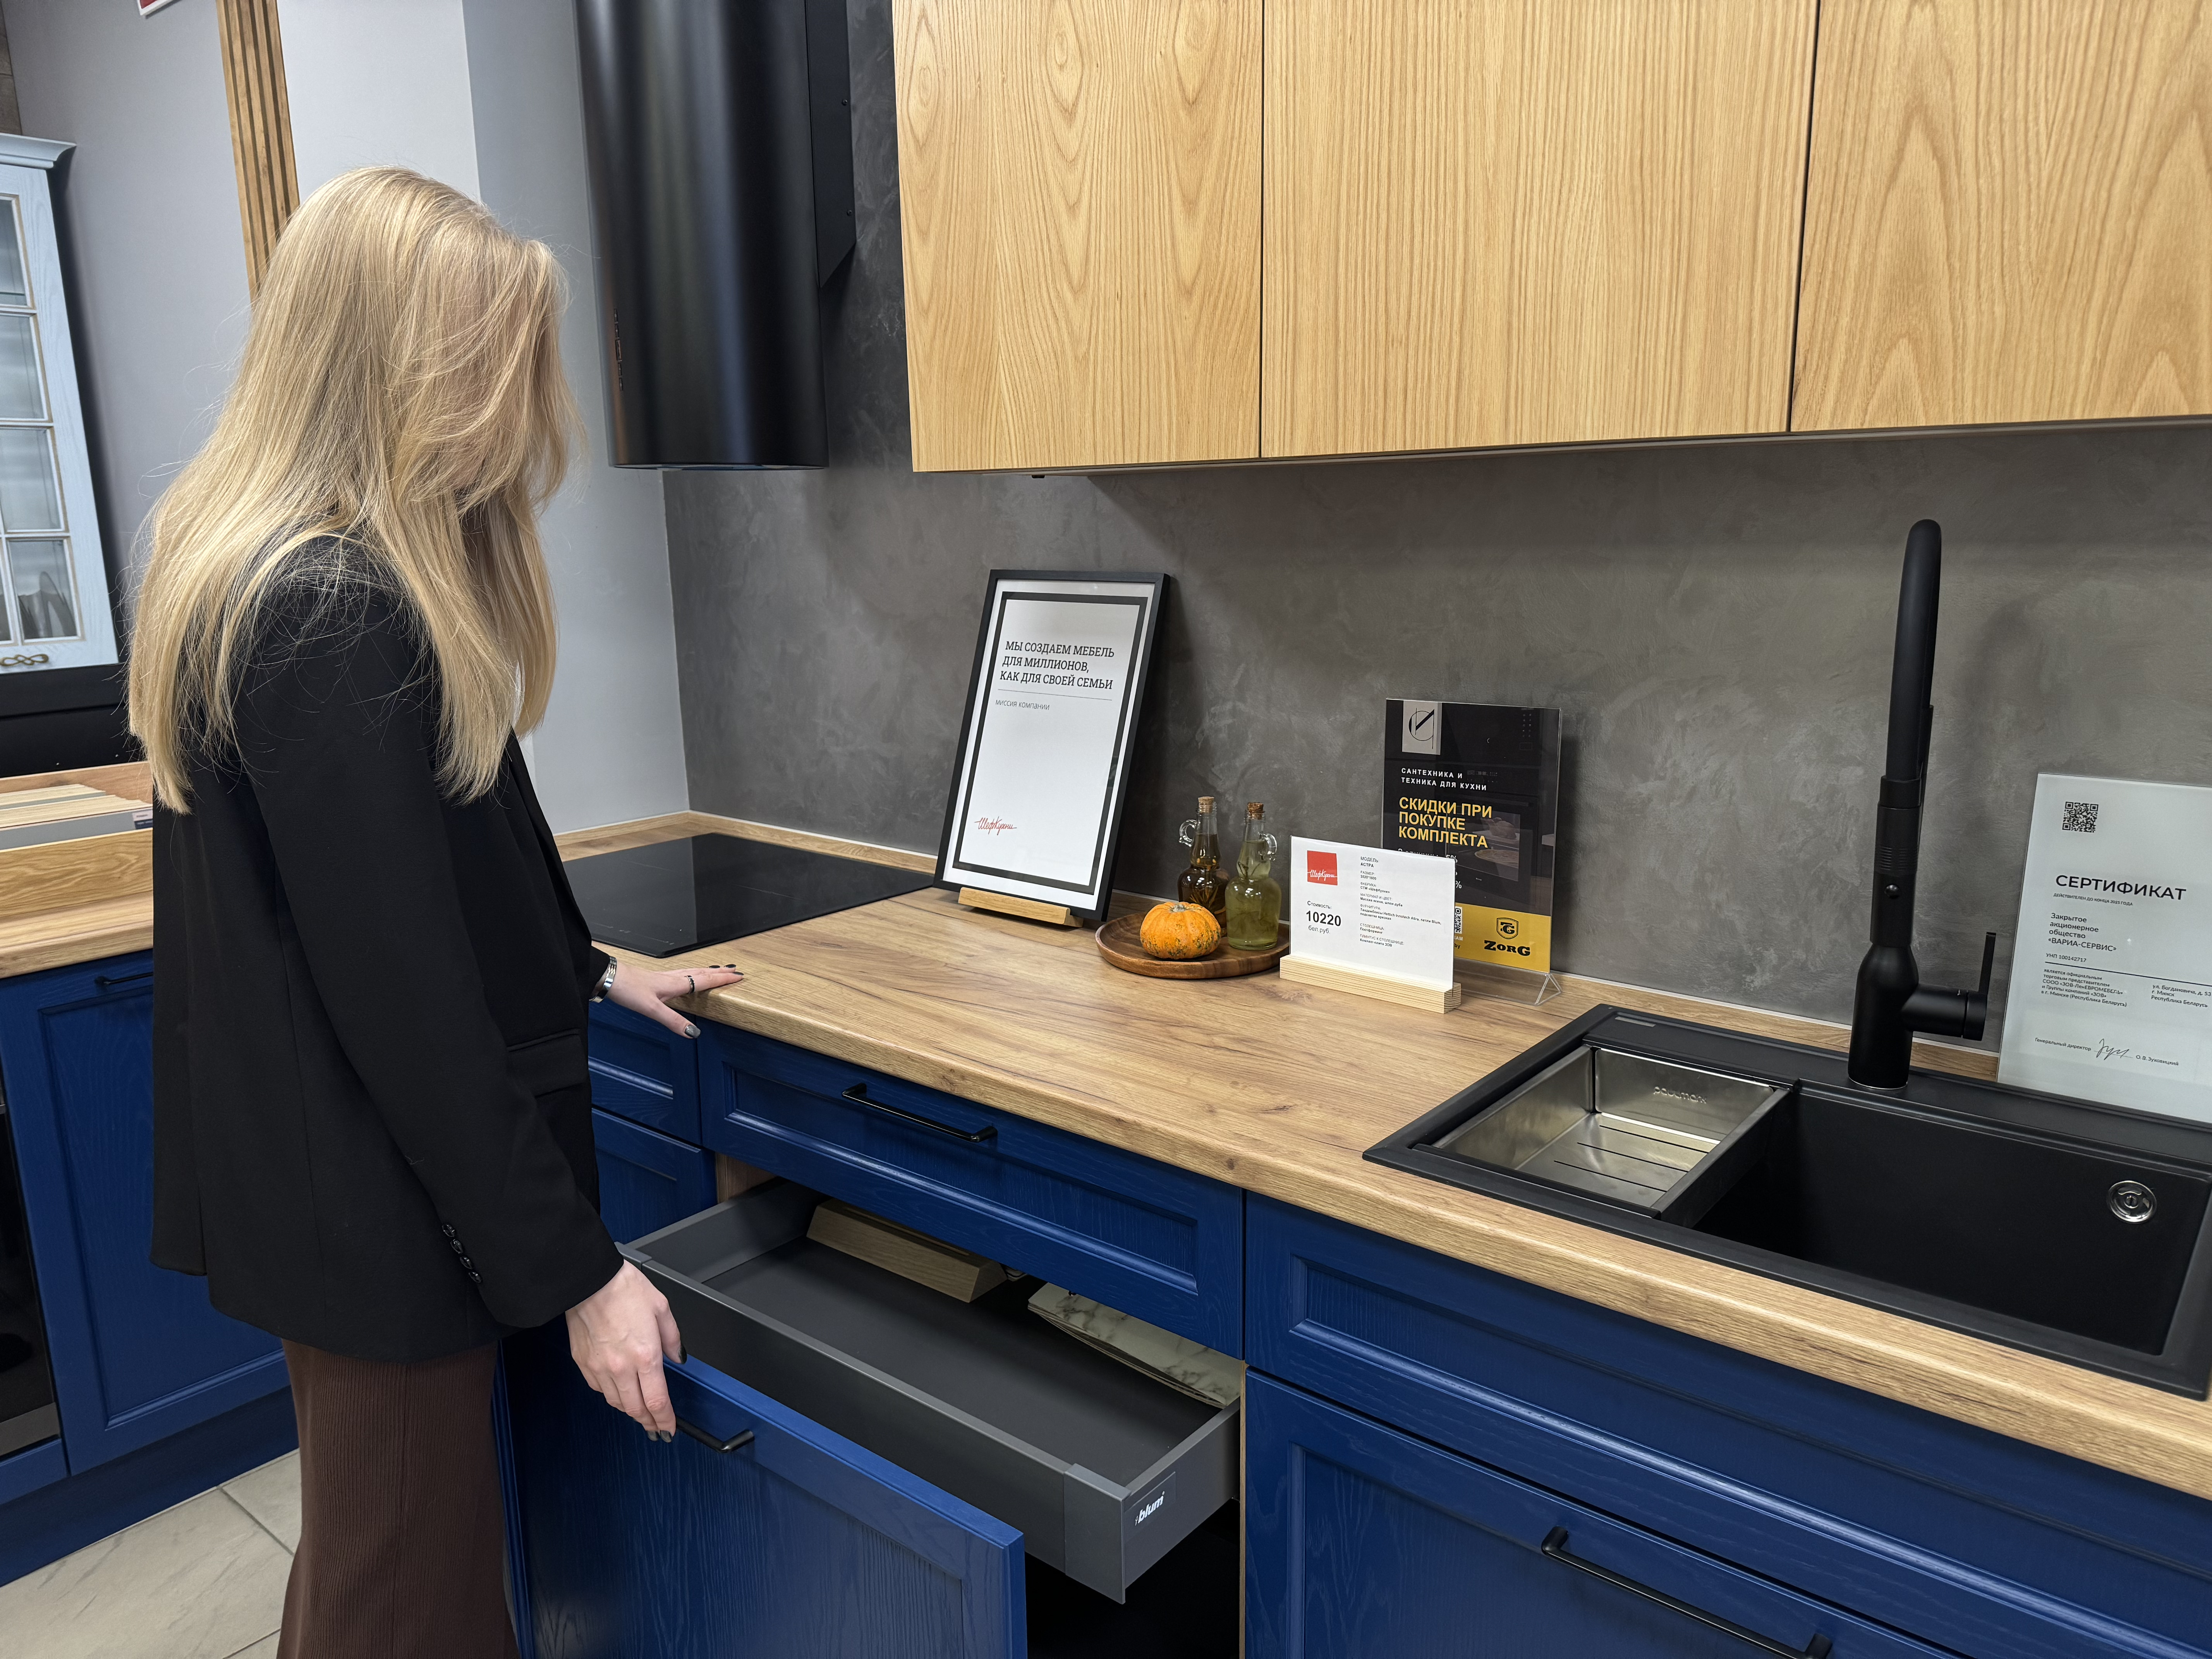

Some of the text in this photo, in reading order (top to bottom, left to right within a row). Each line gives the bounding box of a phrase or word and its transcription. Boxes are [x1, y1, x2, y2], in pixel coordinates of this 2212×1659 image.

[1005, 641, 1114, 657] МЫ СОЗДАЕМ МЕБЕЛЬ
[1002, 656, 1089, 673] ДЛЯ МИЛЛИОНОВ,
[1000, 671, 1113, 689] КАК ДЛЯ СВОЕЙ СЕМЬИ
[1401, 768, 1454, 778] САНТЕХНИКА
[1401, 777, 1437, 786] ТЕХНИКА
[1460, 783, 1487, 791] КУХНИ
[1399, 797, 1492, 818] СКИДКИ ПРИ
[1399, 811, 1465, 830] ПОКУПКЕ
[1399, 826, 1488, 848] КОМПЛЕКТА
[2056, 875, 2186, 900] СЕРТИФИКАТ
[1306, 910, 1341, 926] 10220
[2051, 913, 2087, 922] Закрытое
[2049, 929, 2086, 938] общество
[2050, 922, 2099, 932] акционерное
[2048, 938, 2117, 951] «ВАРИА-СЕРВИС»
[2035, 1037, 2066, 1046] Генеральный
[1138, 1495, 1164, 1523] blum
